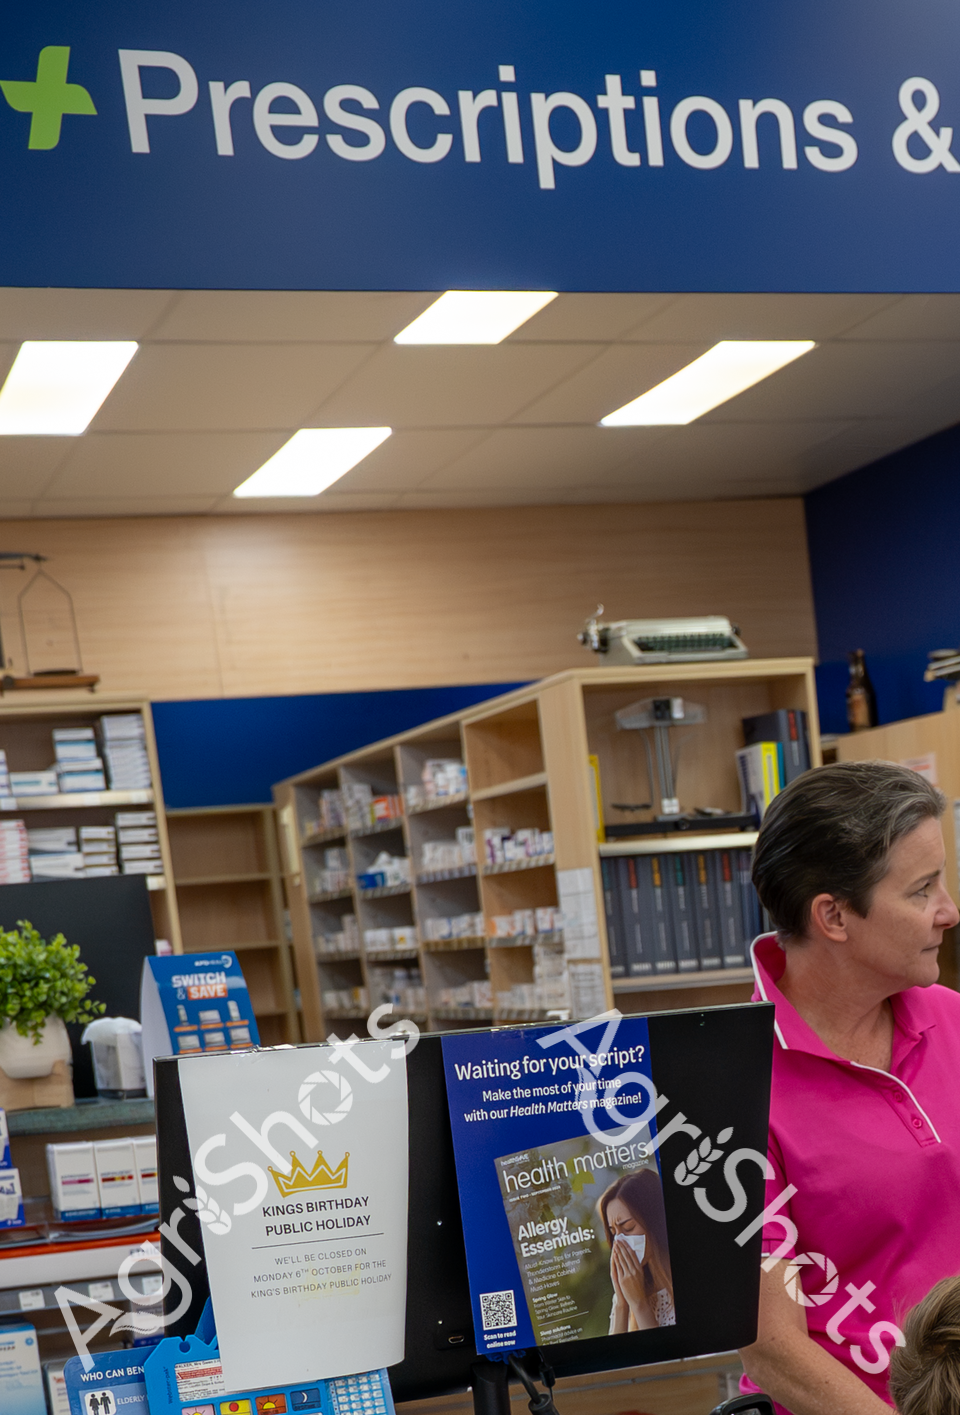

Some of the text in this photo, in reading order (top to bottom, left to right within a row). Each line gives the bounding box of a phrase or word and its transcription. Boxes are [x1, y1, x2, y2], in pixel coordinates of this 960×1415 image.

[118, 49, 858, 189] Prescriptions
[171, 971, 226, 988] SWITCH
[176, 985, 225, 1000] & SAVE
[454, 1045, 645, 1081] Waiting for your script?
[482, 1078, 622, 1102] Make the most of your time
[463, 1092, 642, 1122] with our Health Matters magazine!
[502, 1140, 649, 1193] health matters
[622, 1158, 649, 1170] magazine
[262, 1196, 369, 1217] KINGS BIRTHDAY
[265, 1215, 371, 1236] PUBLIC HOLIDAY
[518, 1216, 568, 1241] Allergy
[520, 1226, 595, 1257] Essentials:
[274, 1248, 367, 1265] WE'LL BE CLOSED ON
[524, 1255, 564, 1270] Must-Know Tips
[253, 1271, 294, 1283] MONDAY
[311, 1264, 353, 1277] OCTOBER
[354, 1262, 371, 1271] FOR
[372, 1260, 387, 1269] THE
[527, 1259, 581, 1277] Thunderstorm Asthma
[533, 1267, 576, 1284] Medicine Cabinet
[251, 1273, 393, 1299] KING'S BIRTHDAY PUBLIC HOLIDAY
[530, 1280, 560, 1293] Must-Haves
[483, 1329, 517, 1341] Scan to read
[486, 1339, 516, 1349] online now
[80, 1366, 145, 1382] WHO CAN BEN
[117, 1395, 145, 1405] ELDERLY
